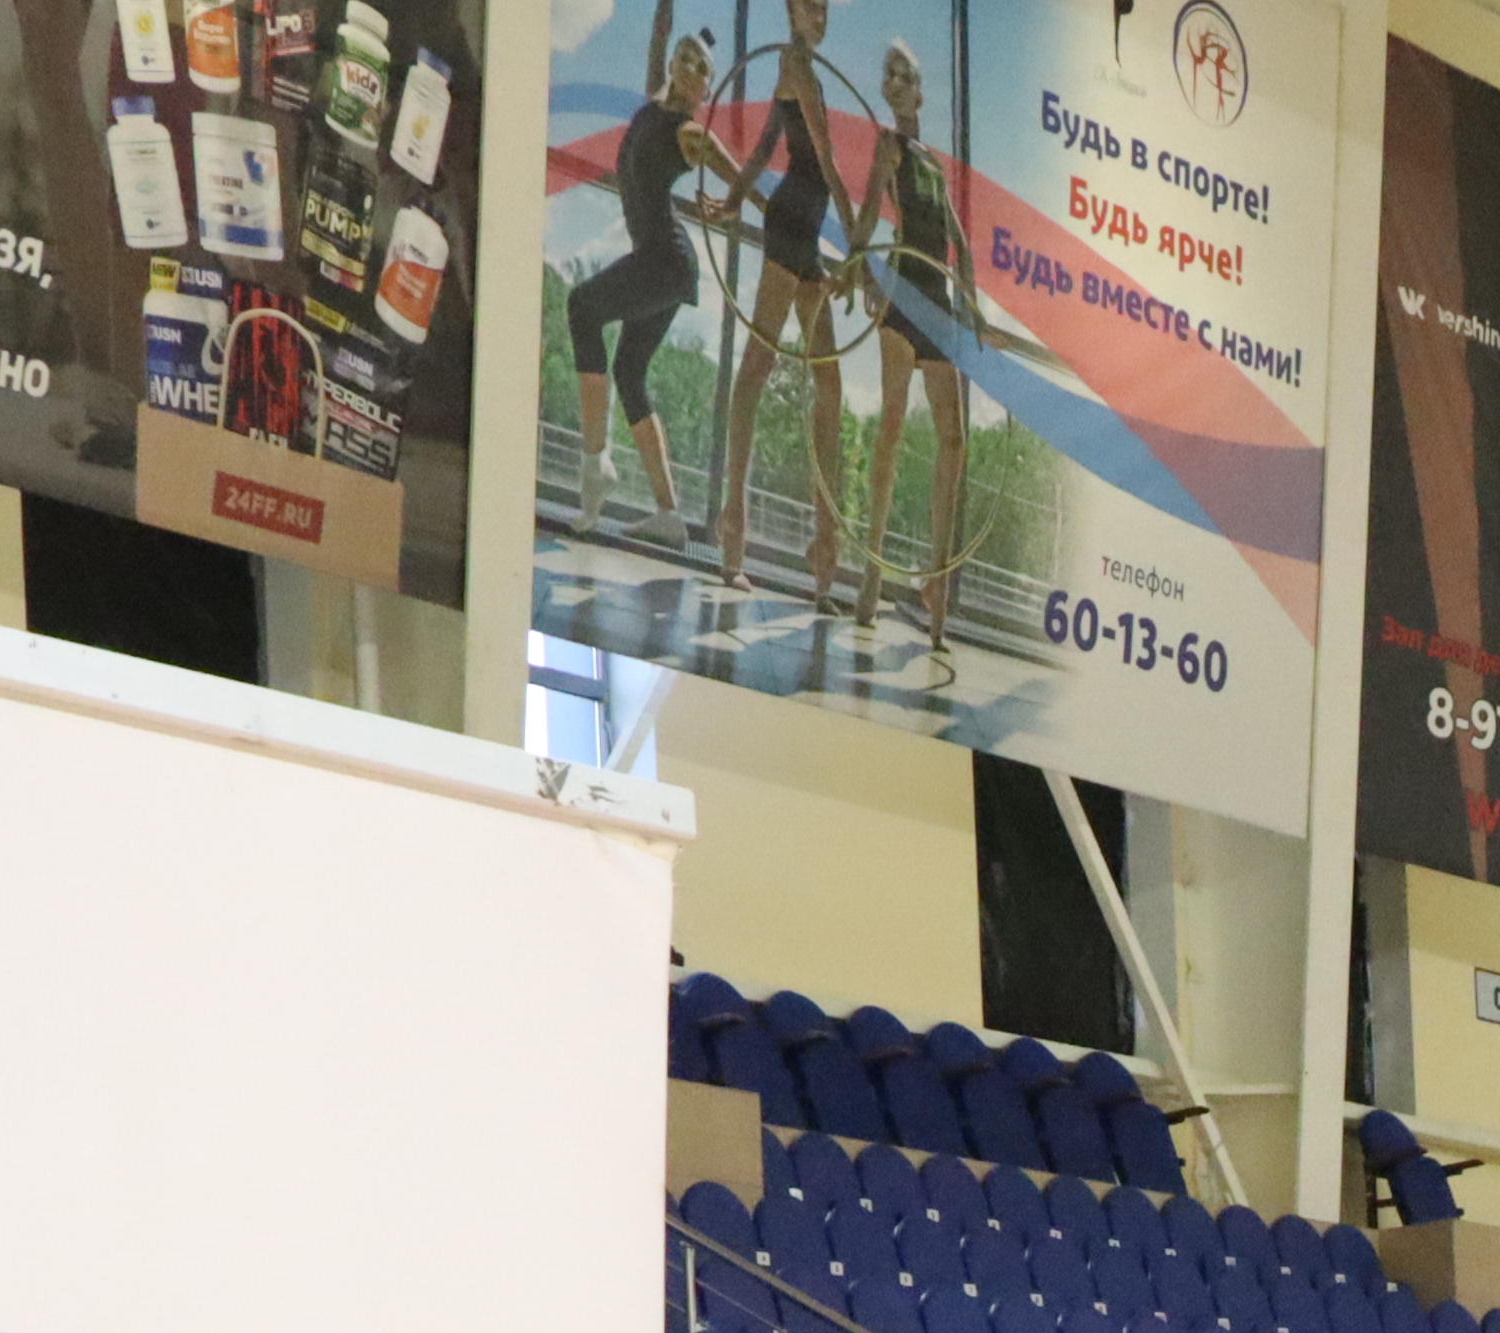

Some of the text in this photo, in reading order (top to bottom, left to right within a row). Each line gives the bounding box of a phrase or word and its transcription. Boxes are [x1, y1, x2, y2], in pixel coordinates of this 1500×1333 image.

[1041, 90, 1270, 225] Будь в спорте!
[1069, 175, 1244, 286] Будь ярче!
[990, 226, 1302, 389] Будь вместе с нами!
[225, 485, 314, 529] 24FF.RU
[1101, 555, 1185, 602] телефон
[1044, 589, 1228, 693] 60-13-60
